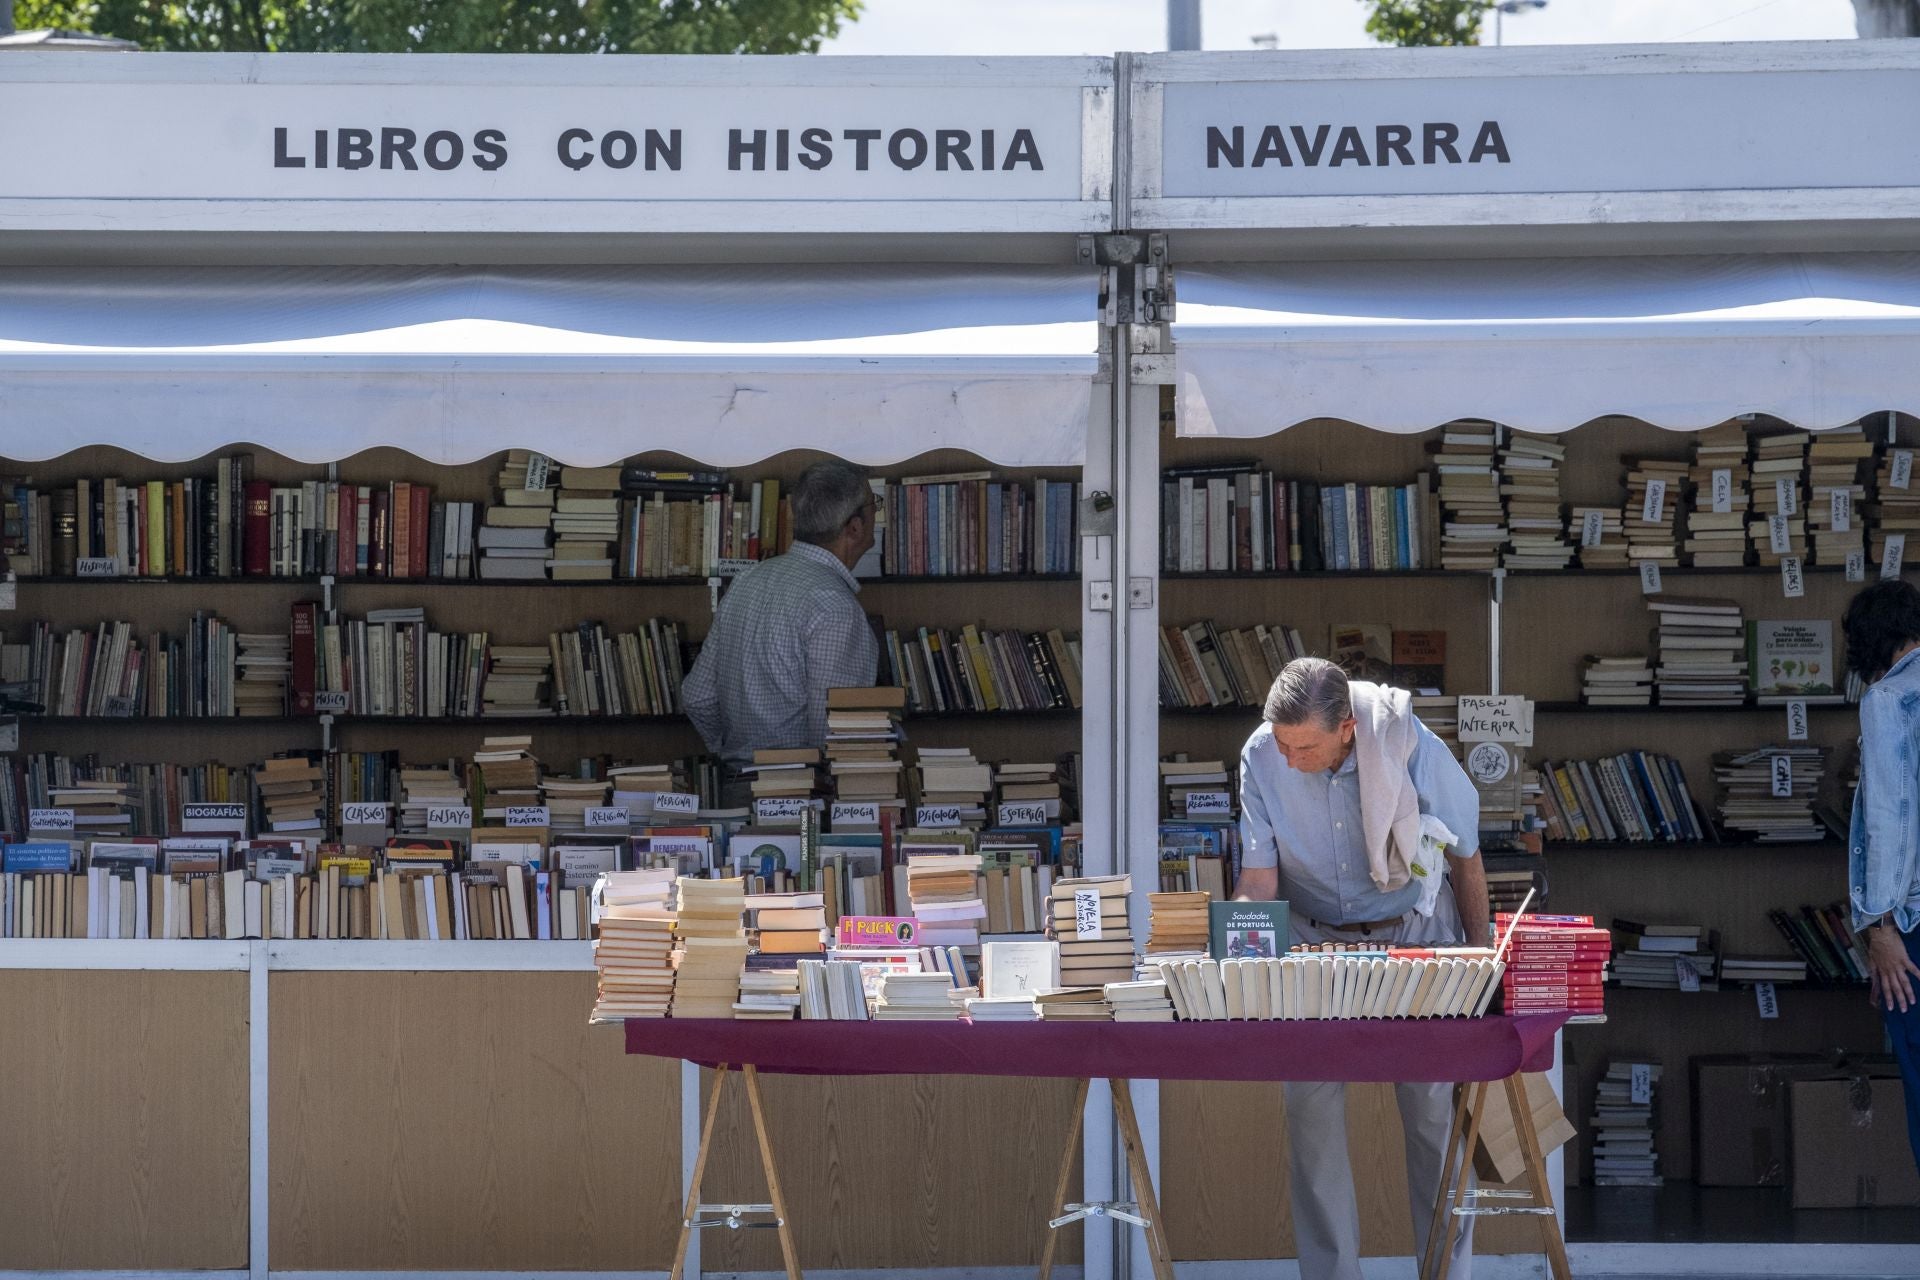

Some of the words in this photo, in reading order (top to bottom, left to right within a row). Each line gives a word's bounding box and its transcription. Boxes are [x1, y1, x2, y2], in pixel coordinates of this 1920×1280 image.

[274, 127, 508, 171] LIBROS
[557, 128, 682, 171] CON
[728, 128, 1044, 171] HISTORIA
[1206, 121, 1511, 168] NAVARRA
[1462, 698, 1507, 710] PASEN
[1493, 708, 1510, 716] AL
[1460, 716, 1519, 737] INTERIOR
[185, 806, 245, 817] BIOGRAFÍAS
[429, 809, 470, 825] ENSAYO
[1082, 894, 1097, 932] NOVELA
[1232, 911, 1270, 920] Saudades
[856, 920, 894, 934] PUCK
